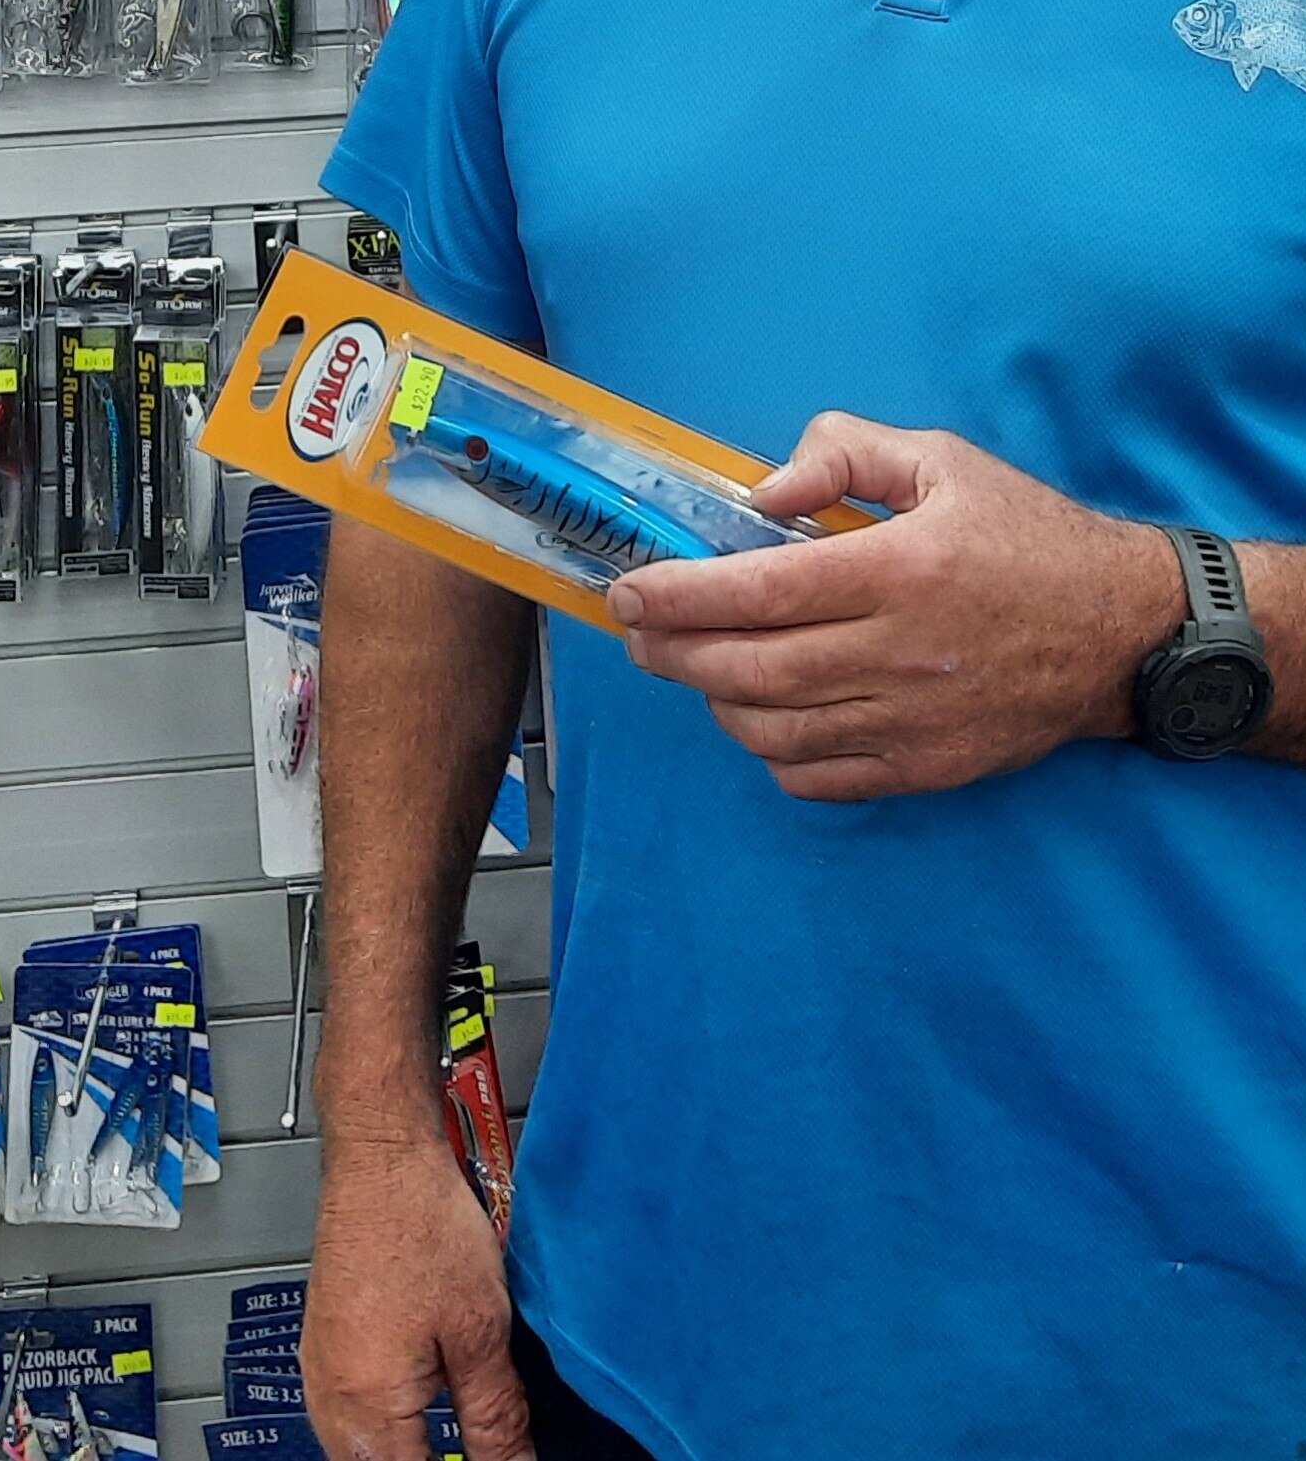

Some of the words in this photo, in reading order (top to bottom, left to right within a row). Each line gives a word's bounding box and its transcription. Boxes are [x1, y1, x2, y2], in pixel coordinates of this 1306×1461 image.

[155, 293, 201, 311] STORM
[62, 336, 79, 419] So-Run
[300, 336, 360, 439] HALCO
[412, 367, 436, 411] $22.90
[139, 353, 155, 437] So-Run
[62, 421, 75, 463] Heavy
[139, 439, 152, 483] Heavy
[270, 588, 319, 608] Walker
[476, 1070, 489, 1105] PRO
[247, 1294, 278, 1311] SIZE:
[281, 1291, 301, 1306] 3.5
[94, 1320, 101, 1333] 3
[104, 1318, 138, 1332] PACK
[57, 1369, 81, 1387] JIG
[85, 1367, 124, 1385] PACK
[247, 1385, 278, 1401] SIZE:
[282, 1388, 302, 1402] 3.5
[220, 1431, 255, 1447] SIZE:
[258, 1428, 278, 1444] 3.5
